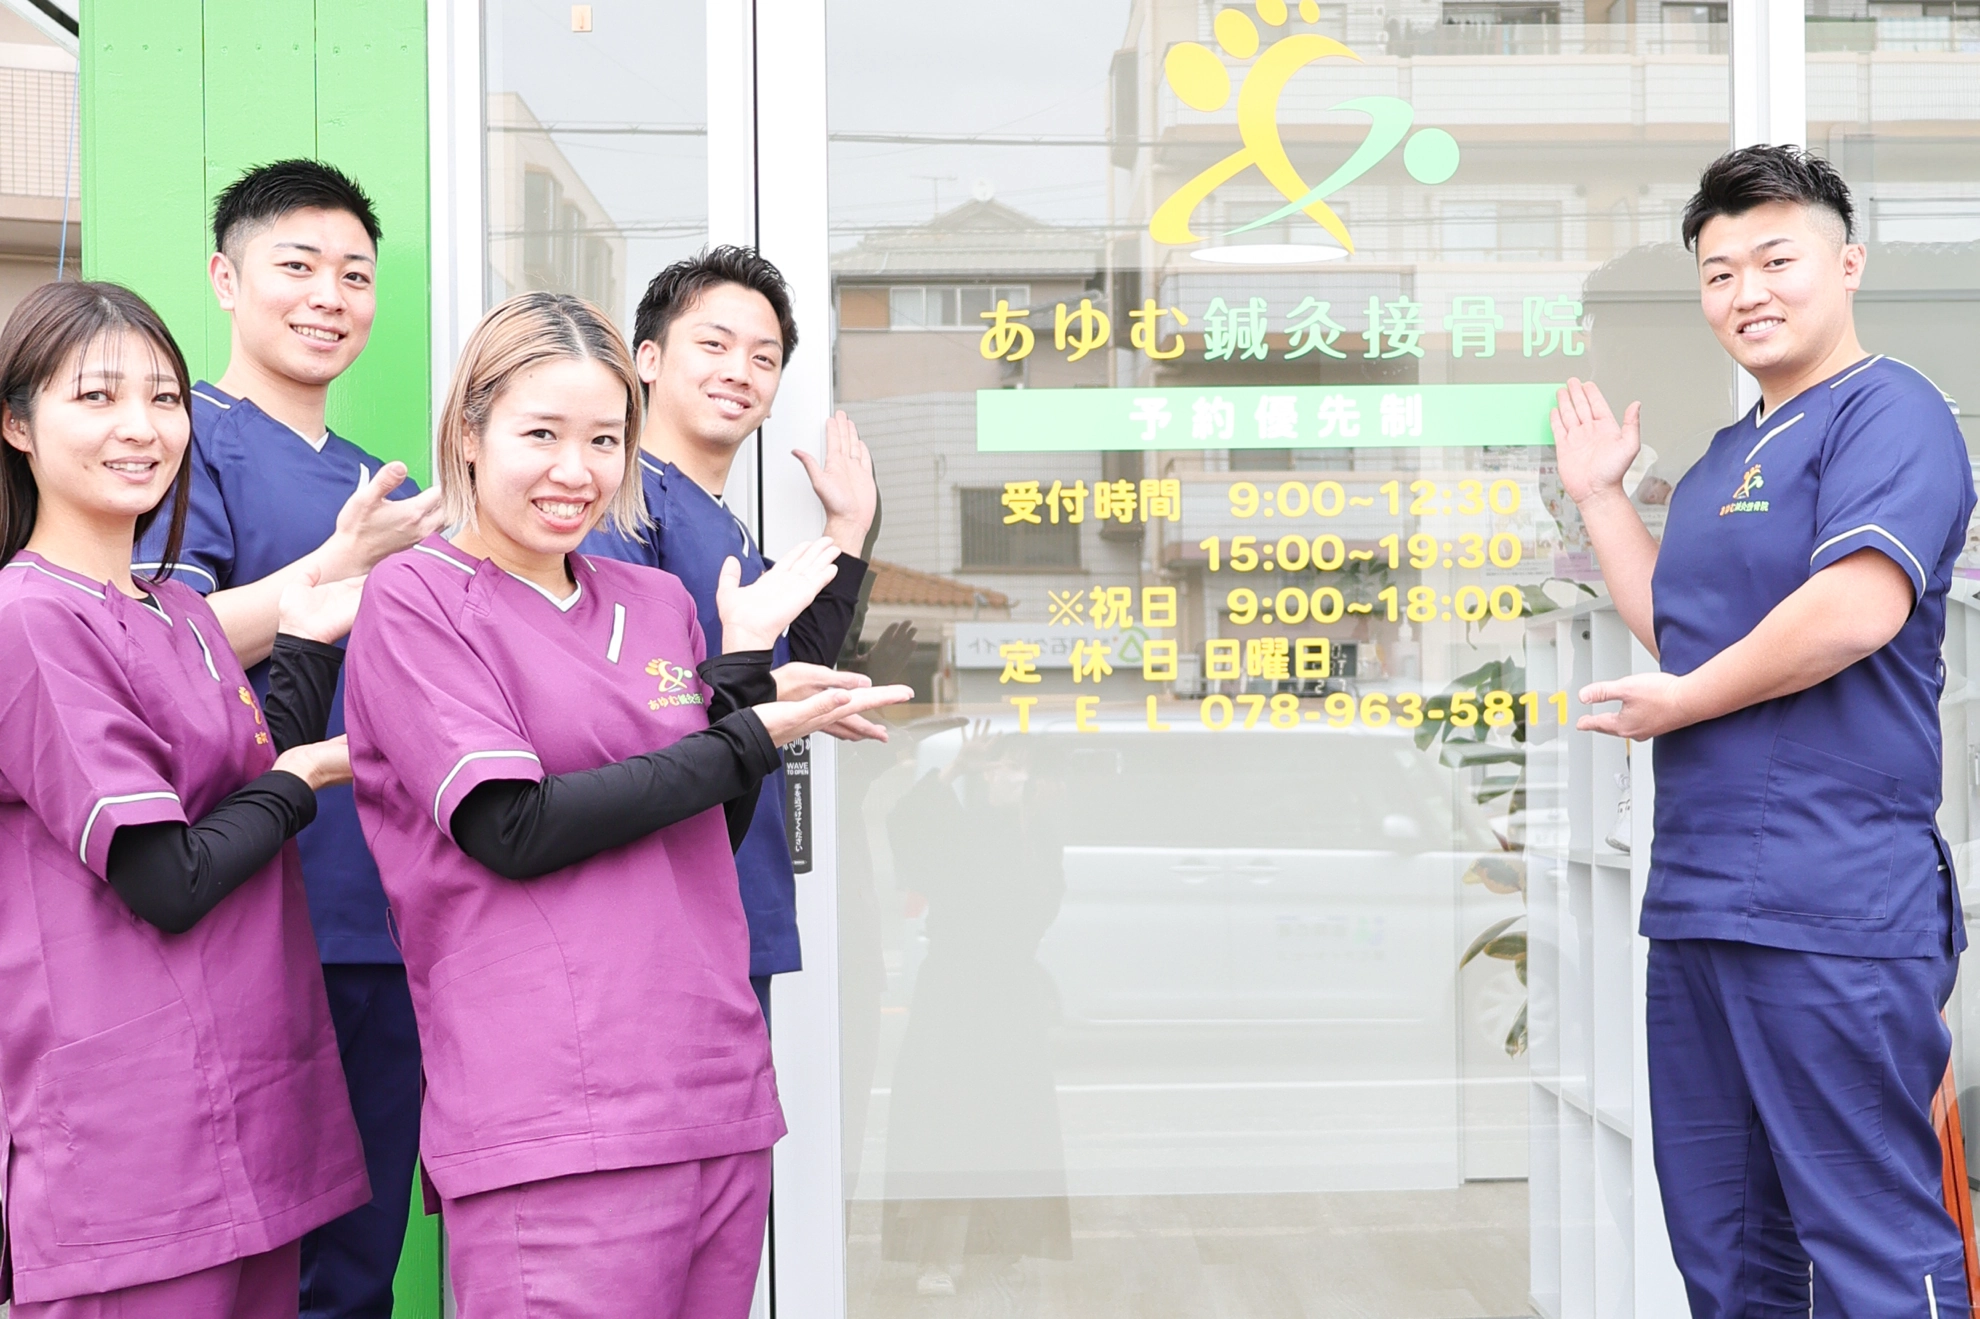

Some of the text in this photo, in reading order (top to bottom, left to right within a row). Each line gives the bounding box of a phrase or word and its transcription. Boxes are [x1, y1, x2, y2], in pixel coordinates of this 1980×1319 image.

[979, 294, 1585, 363] あゆむ鍼灸接骨院
[1129, 393, 1424, 441] 予約優先制
[1001, 478, 1181, 525] 受付時間
[1205, 636, 1331, 681] 日曜日
[1200, 690, 1568, 731] 078-963-5811
[787, 762, 809, 770] WAVE
